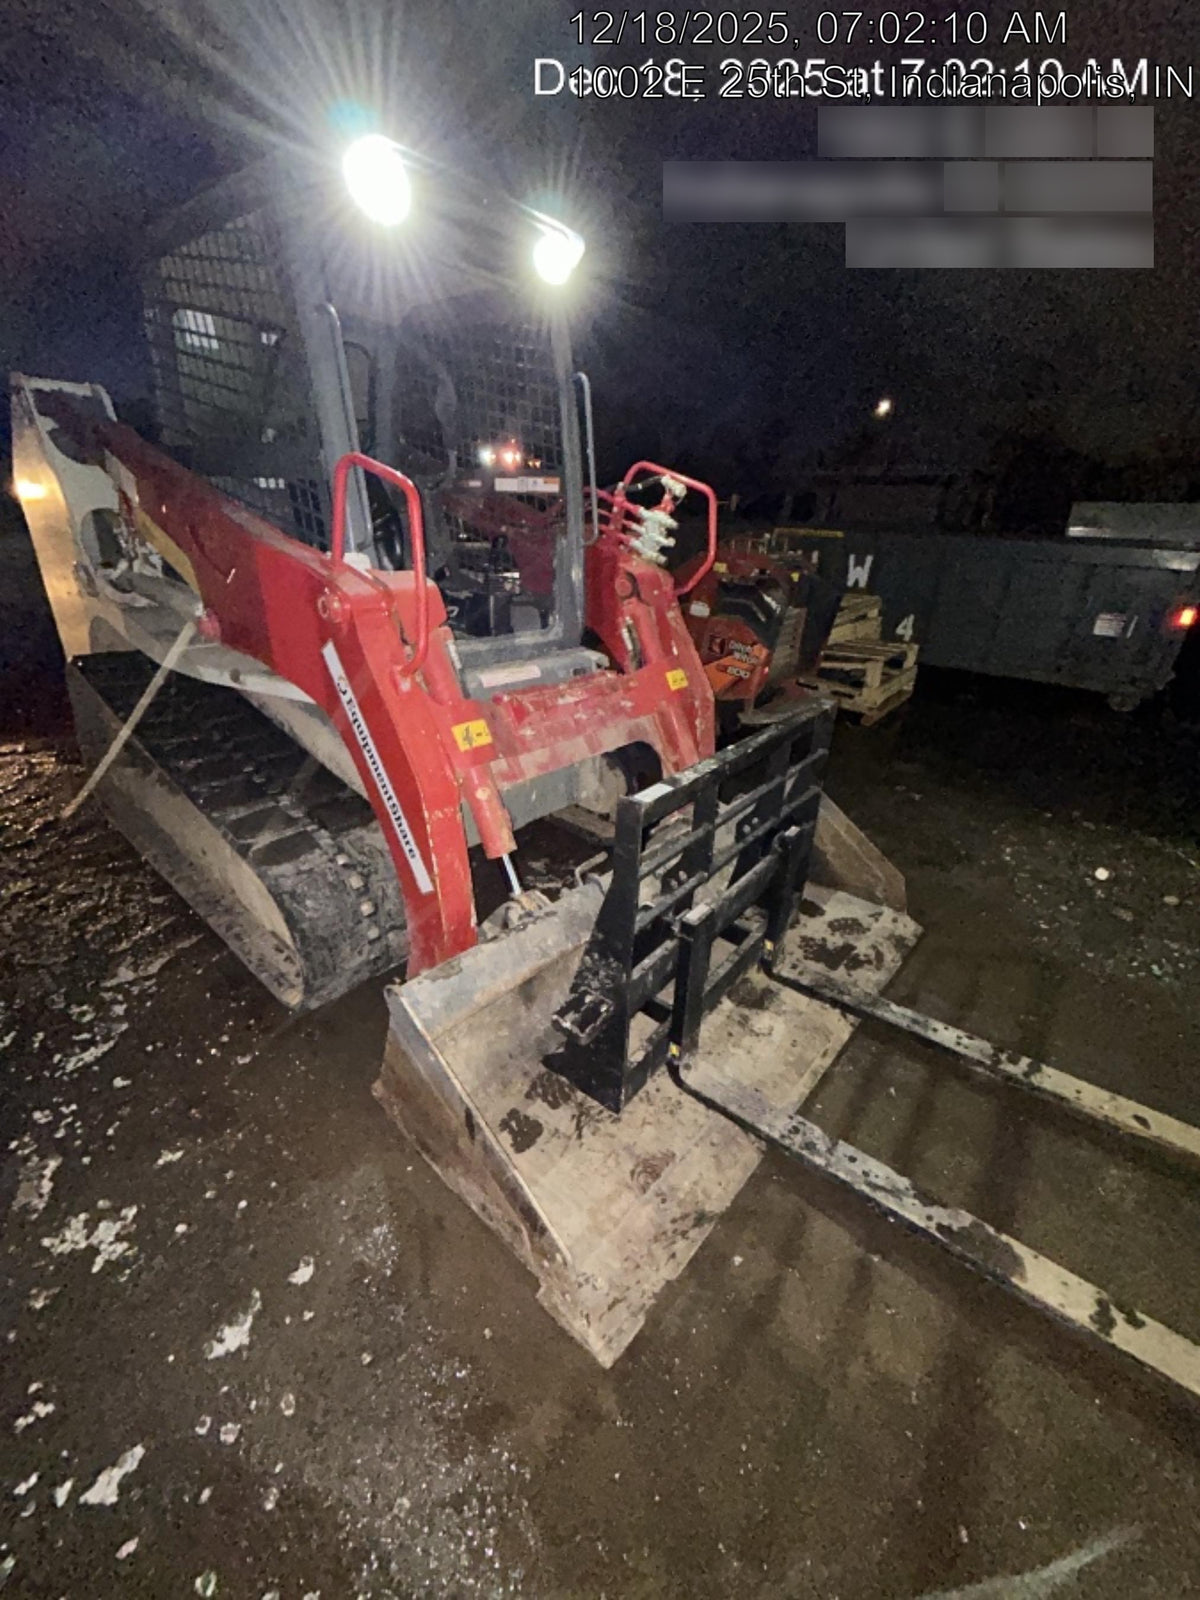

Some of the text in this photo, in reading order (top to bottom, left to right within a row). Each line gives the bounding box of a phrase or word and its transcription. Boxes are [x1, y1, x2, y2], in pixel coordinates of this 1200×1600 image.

[846, 554, 874, 588] W
[895, 614, 915, 642] 4
[346, 697, 417, 860] EquipmentShare
